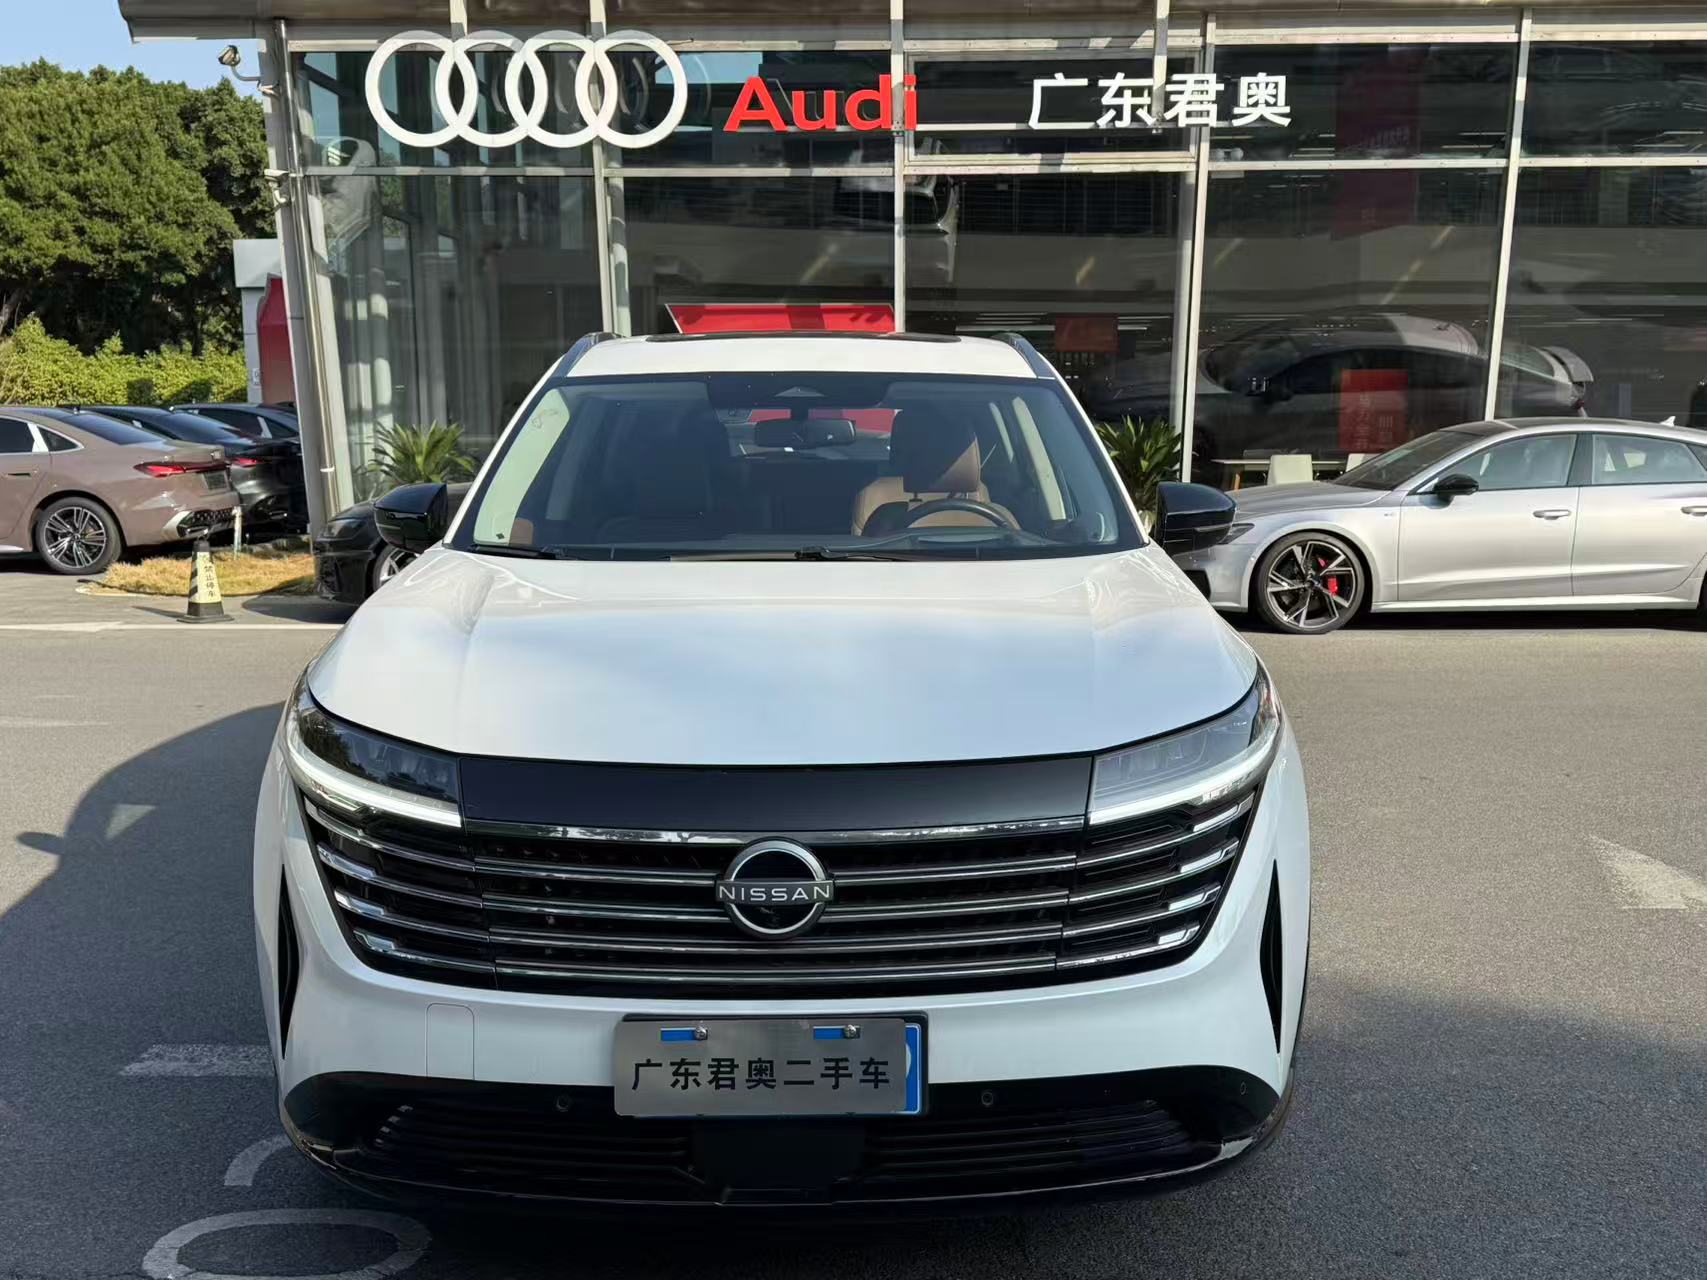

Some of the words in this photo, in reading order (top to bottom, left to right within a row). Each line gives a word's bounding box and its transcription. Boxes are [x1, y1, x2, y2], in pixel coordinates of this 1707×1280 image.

[723, 74, 917, 132] Audi
[1028, 72, 1292, 128] 广东君奥
[719, 885, 830, 901] NISSAN
[632, 1057, 890, 1091] 广东君奥二手车
